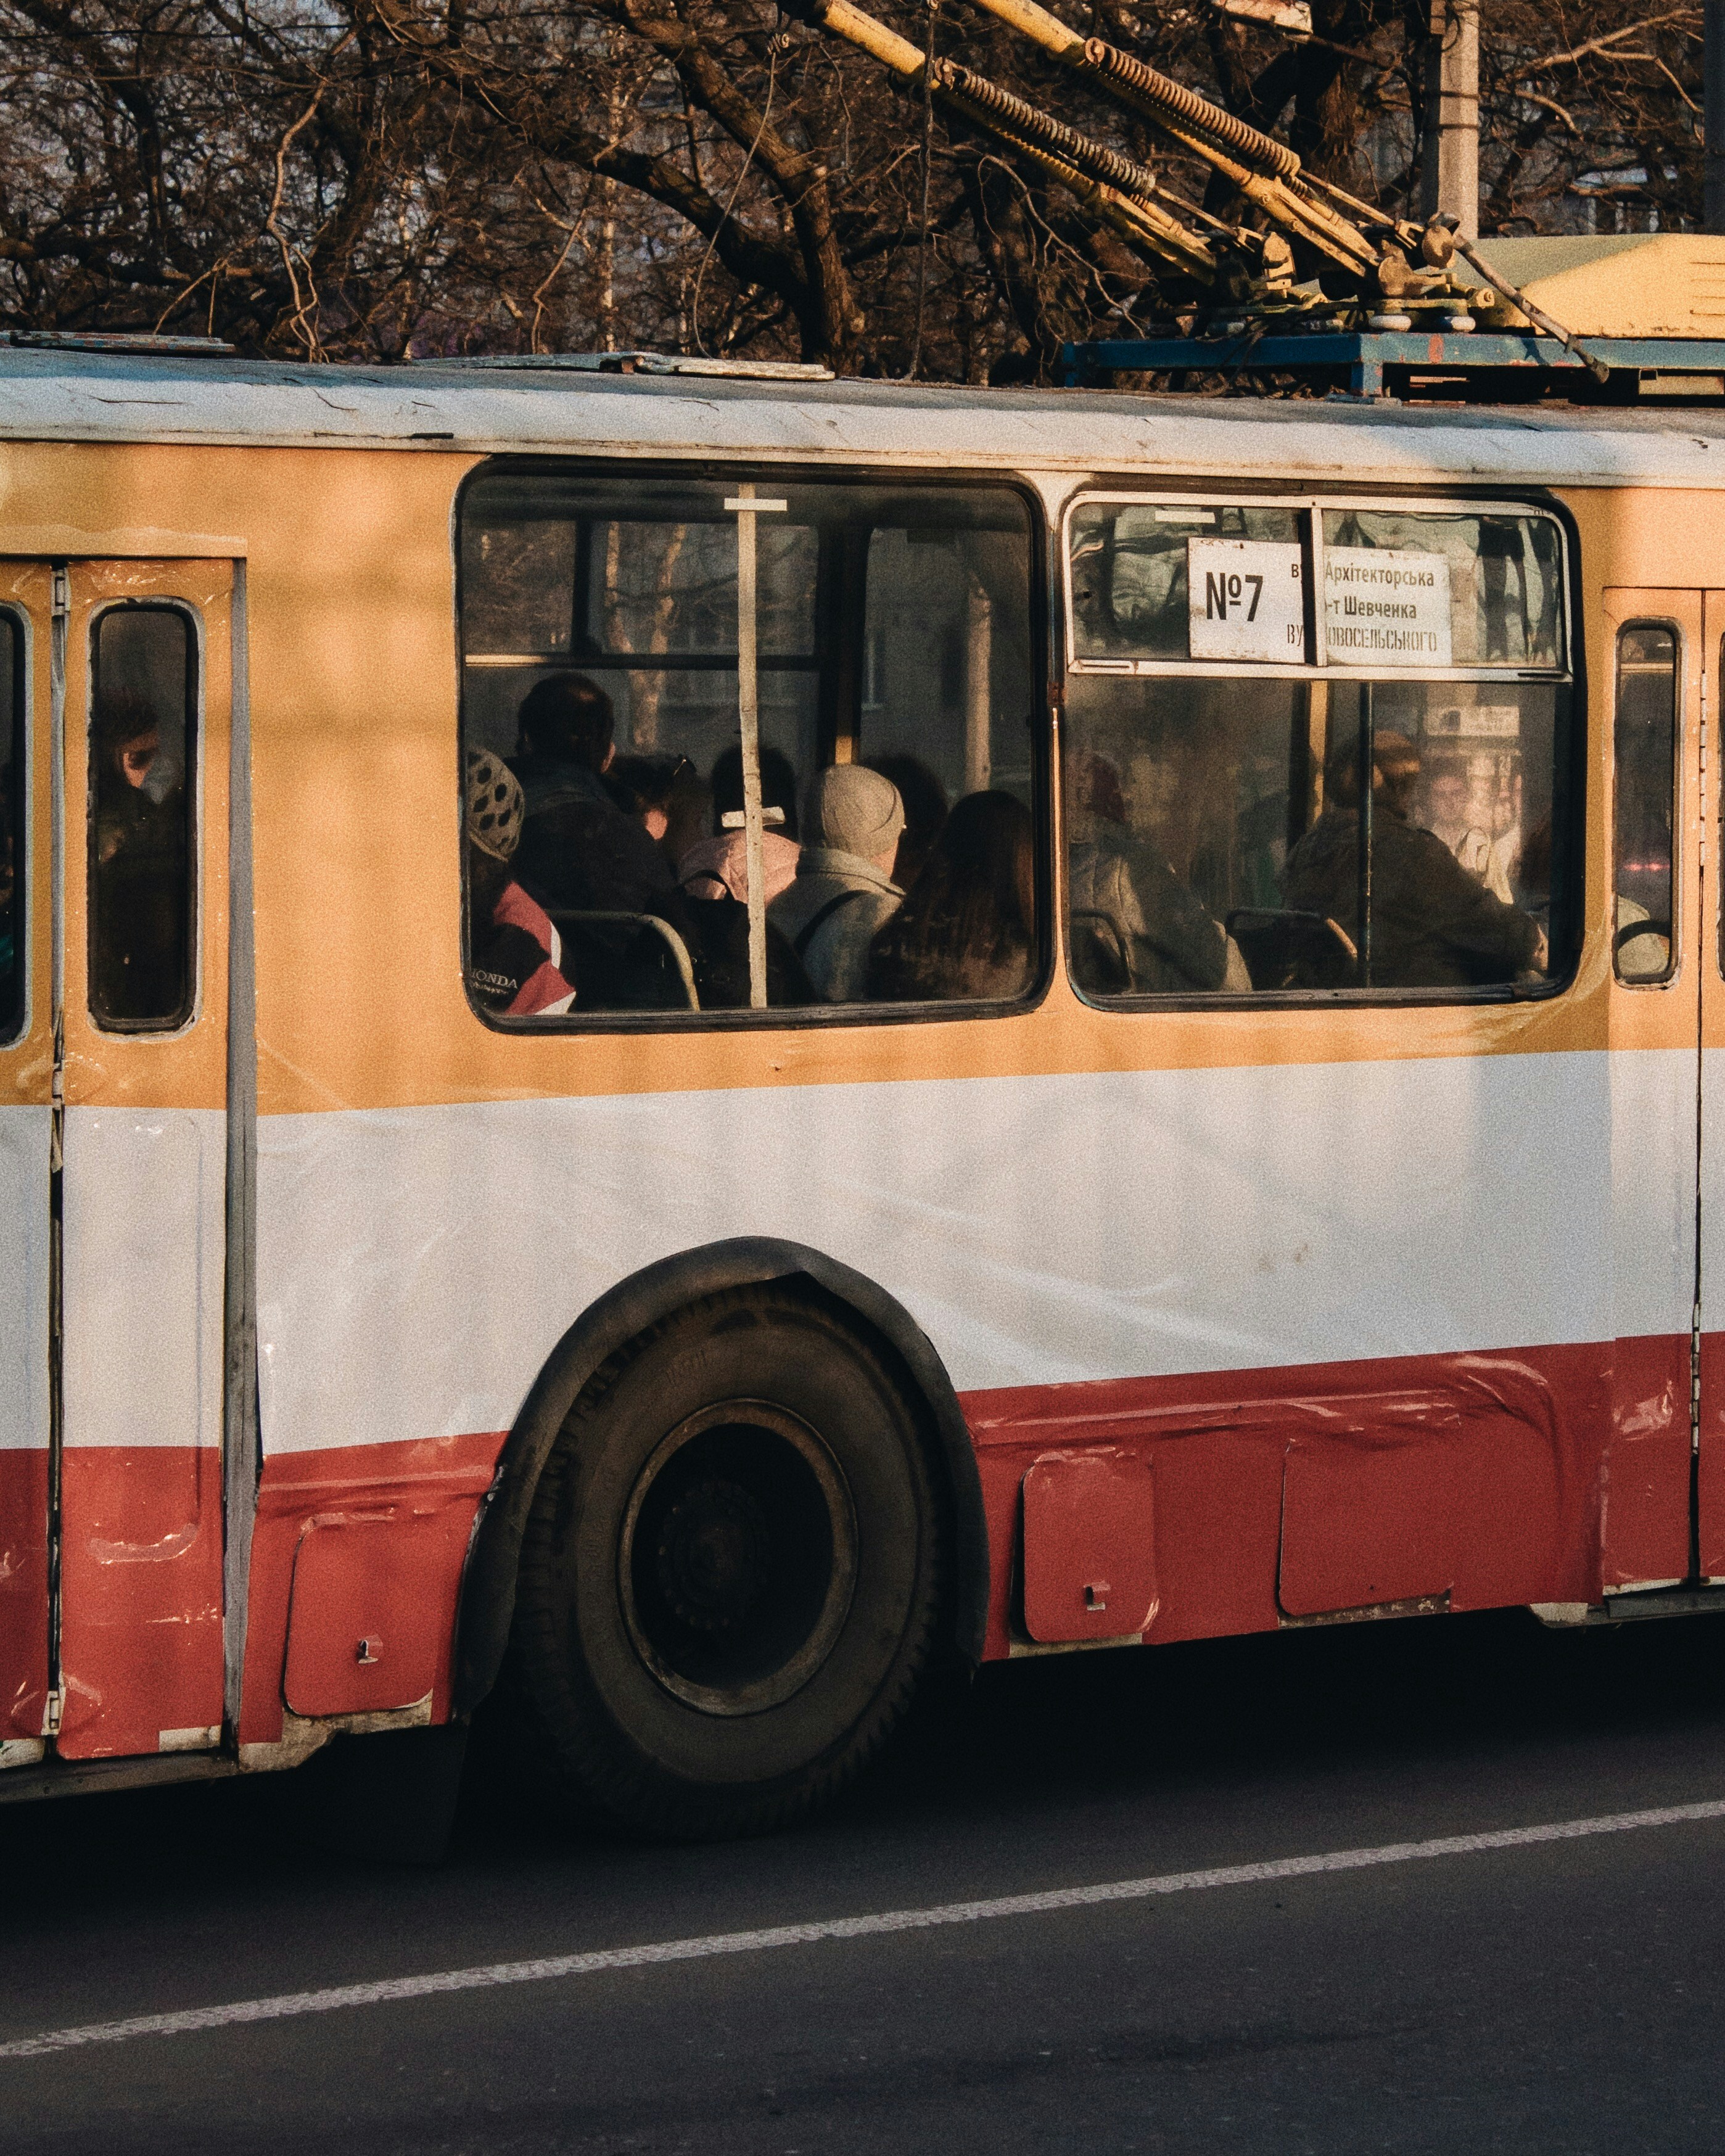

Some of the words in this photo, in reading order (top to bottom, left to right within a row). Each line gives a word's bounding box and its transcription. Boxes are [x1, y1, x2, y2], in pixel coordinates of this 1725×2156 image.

[1325, 560, 1435, 589] Архітекторська
[1206, 571, 1264, 622] №7
[1326, 600, 1340, 614] -т
[1344, 596, 1417, 619] Шевченка
